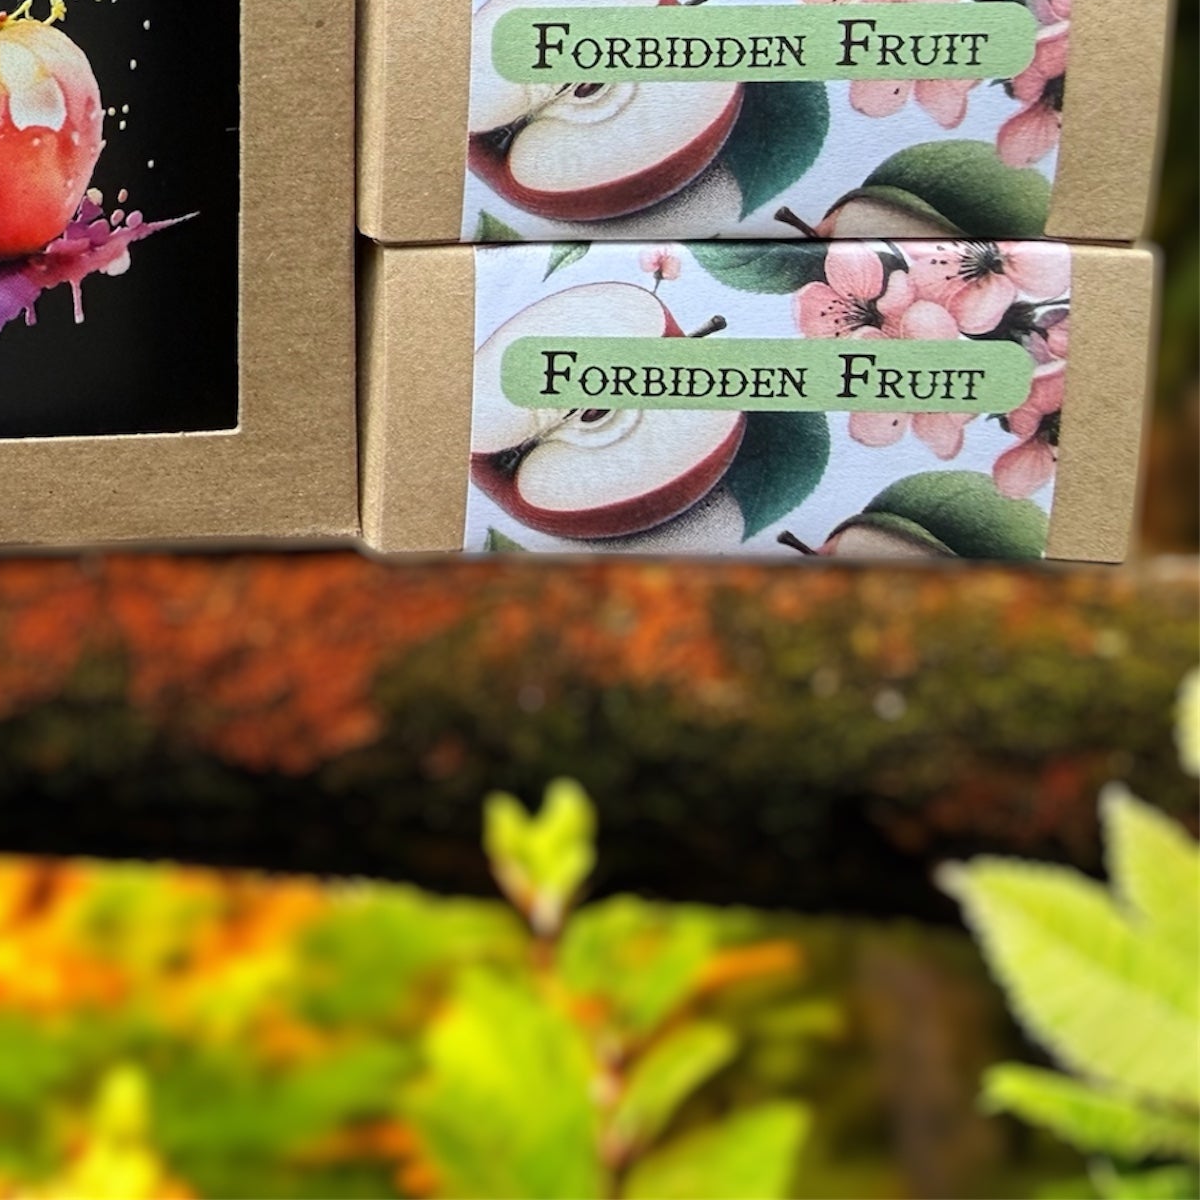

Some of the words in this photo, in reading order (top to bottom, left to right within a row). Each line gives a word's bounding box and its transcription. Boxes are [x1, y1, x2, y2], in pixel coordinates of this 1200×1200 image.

[531, 23, 806, 70] FORBIDDEN
[836, 19, 989, 66] FRUIT
[539, 350, 808, 398] FORBIDDEN
[836, 354, 986, 401] FRUIT
